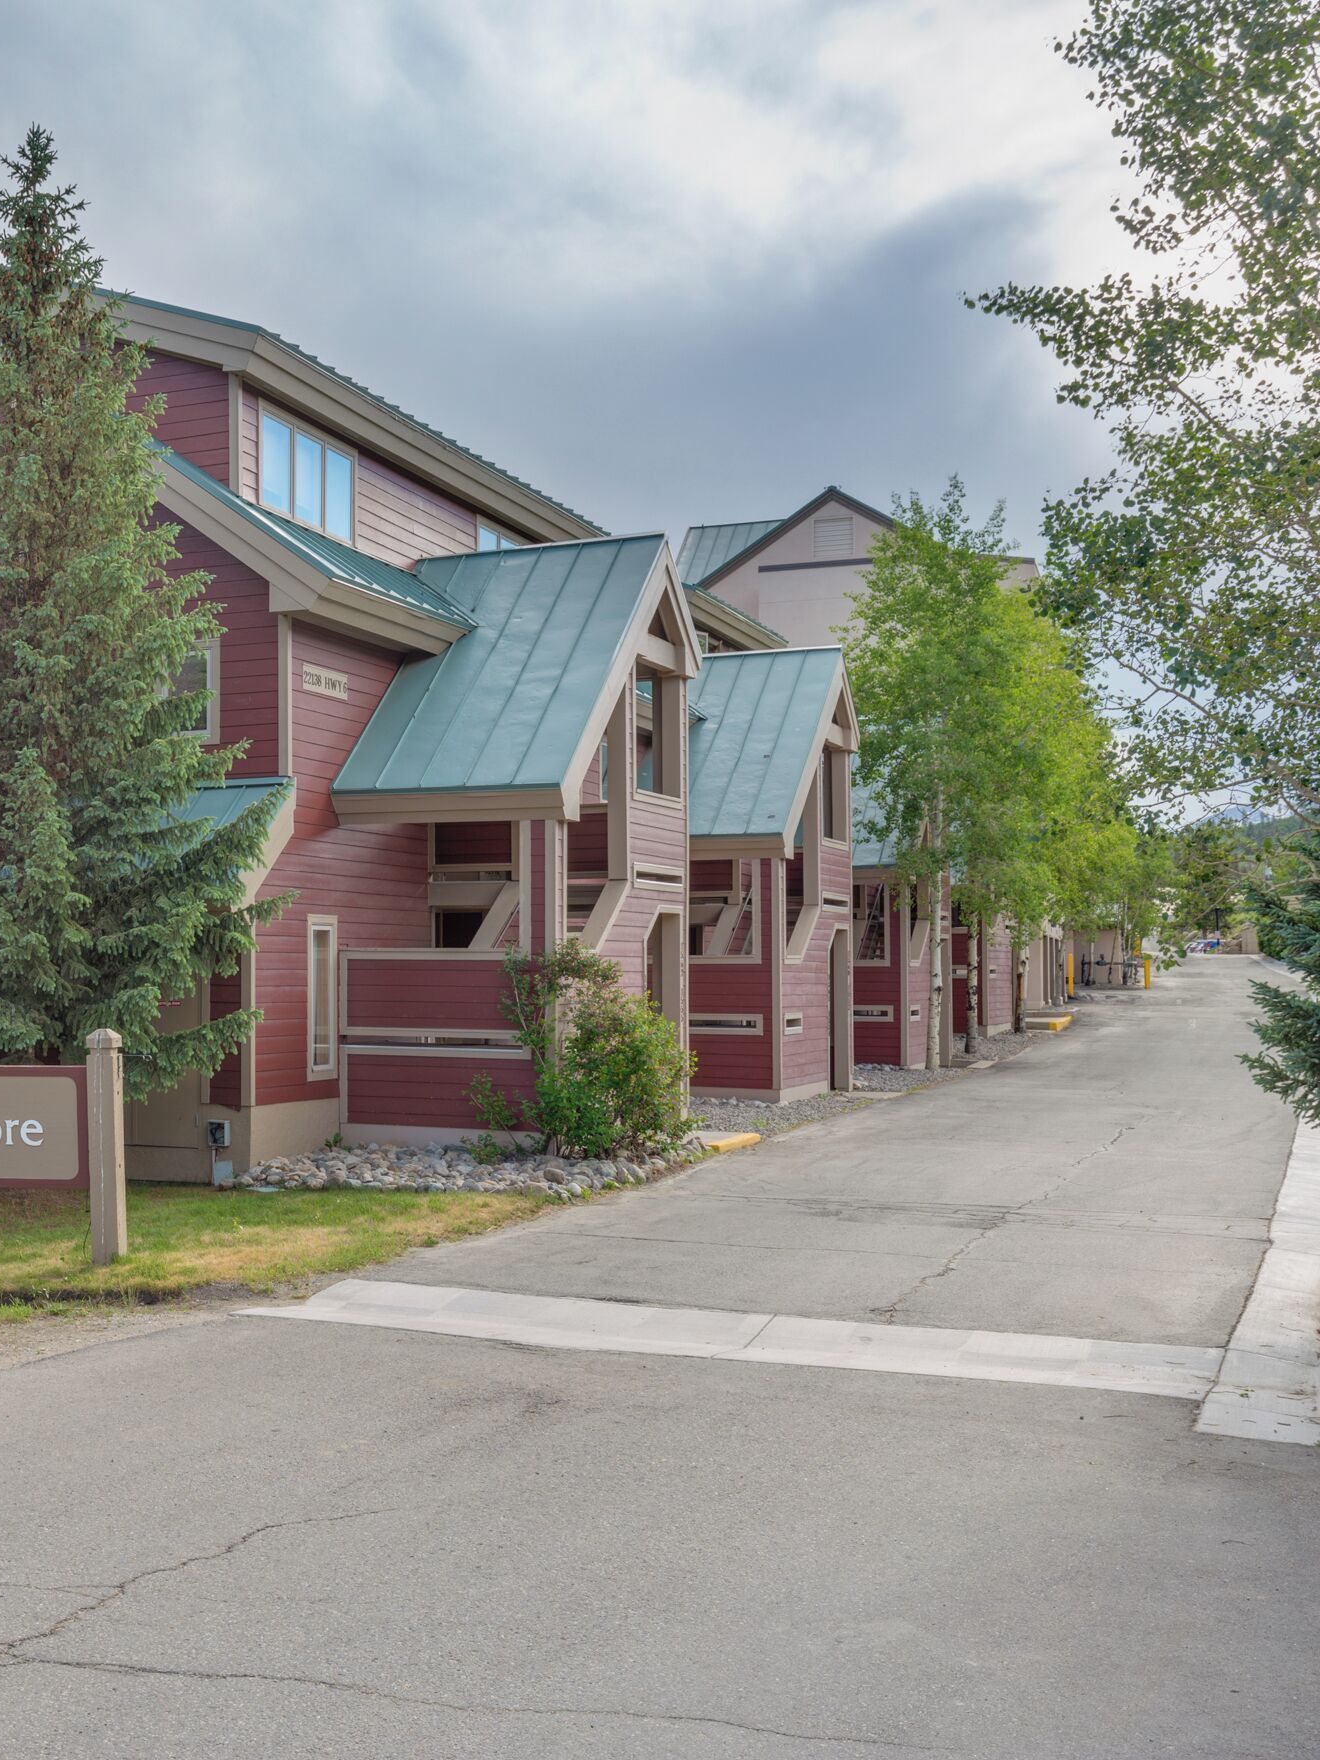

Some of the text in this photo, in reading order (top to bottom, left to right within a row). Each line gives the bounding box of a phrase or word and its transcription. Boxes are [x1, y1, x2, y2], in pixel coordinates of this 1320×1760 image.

[303, 671, 348, 694] 22138 HWY 6
